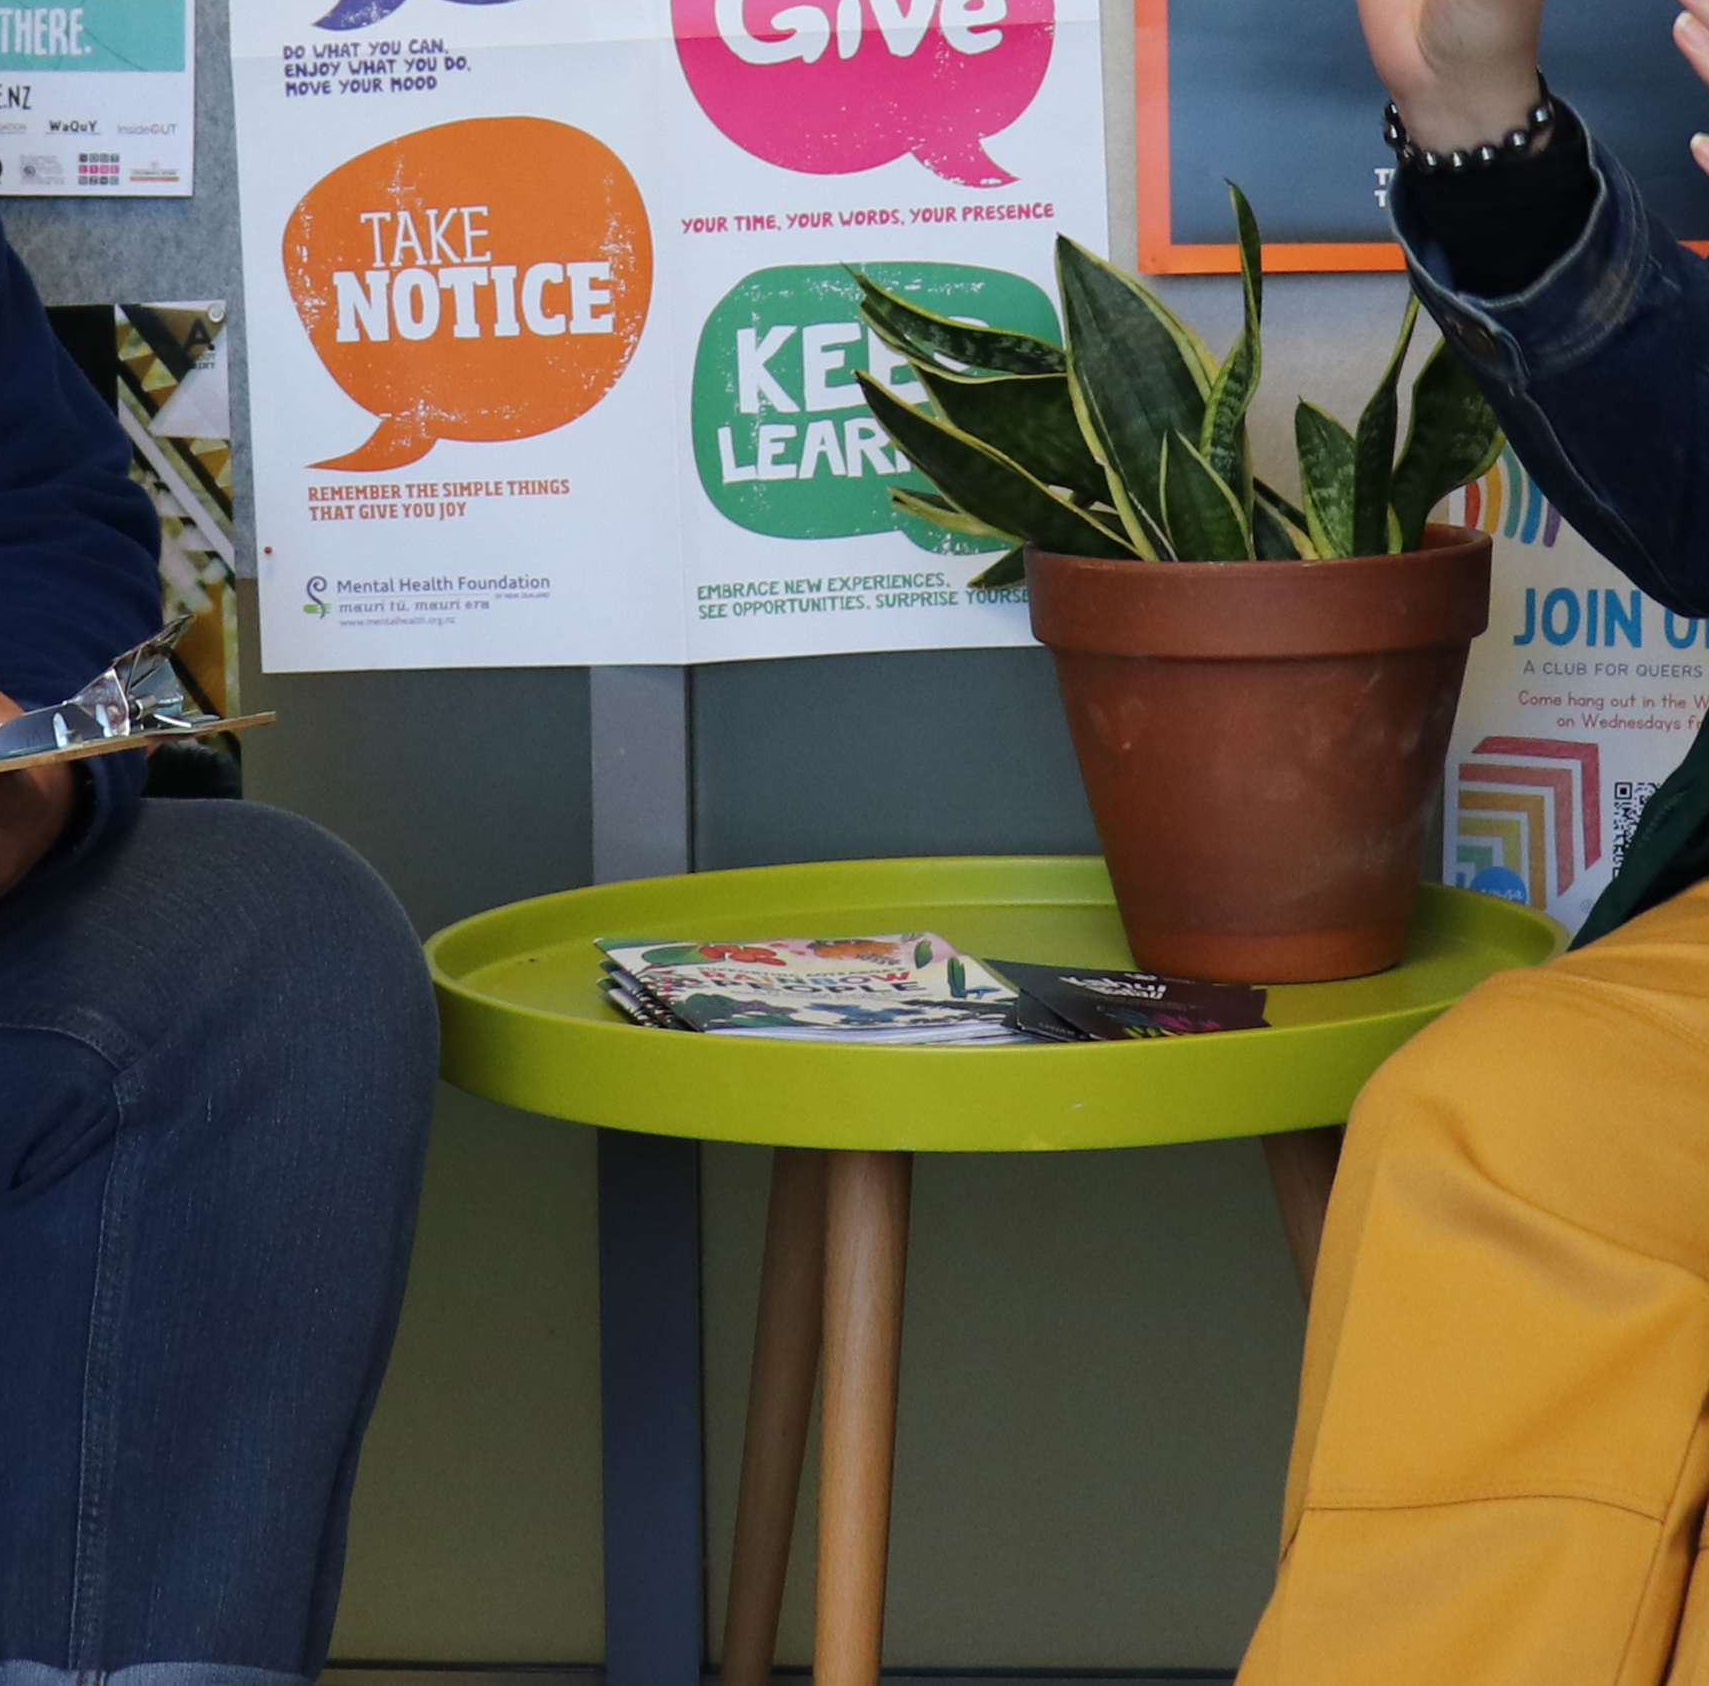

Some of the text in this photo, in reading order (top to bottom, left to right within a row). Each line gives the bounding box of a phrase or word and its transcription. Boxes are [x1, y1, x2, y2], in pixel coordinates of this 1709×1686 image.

[360, 206, 492, 268] TAKE
[332, 260, 615, 344] NOTICE
[1523, 660, 1702, 679] A CLUB FOR QUEERS
